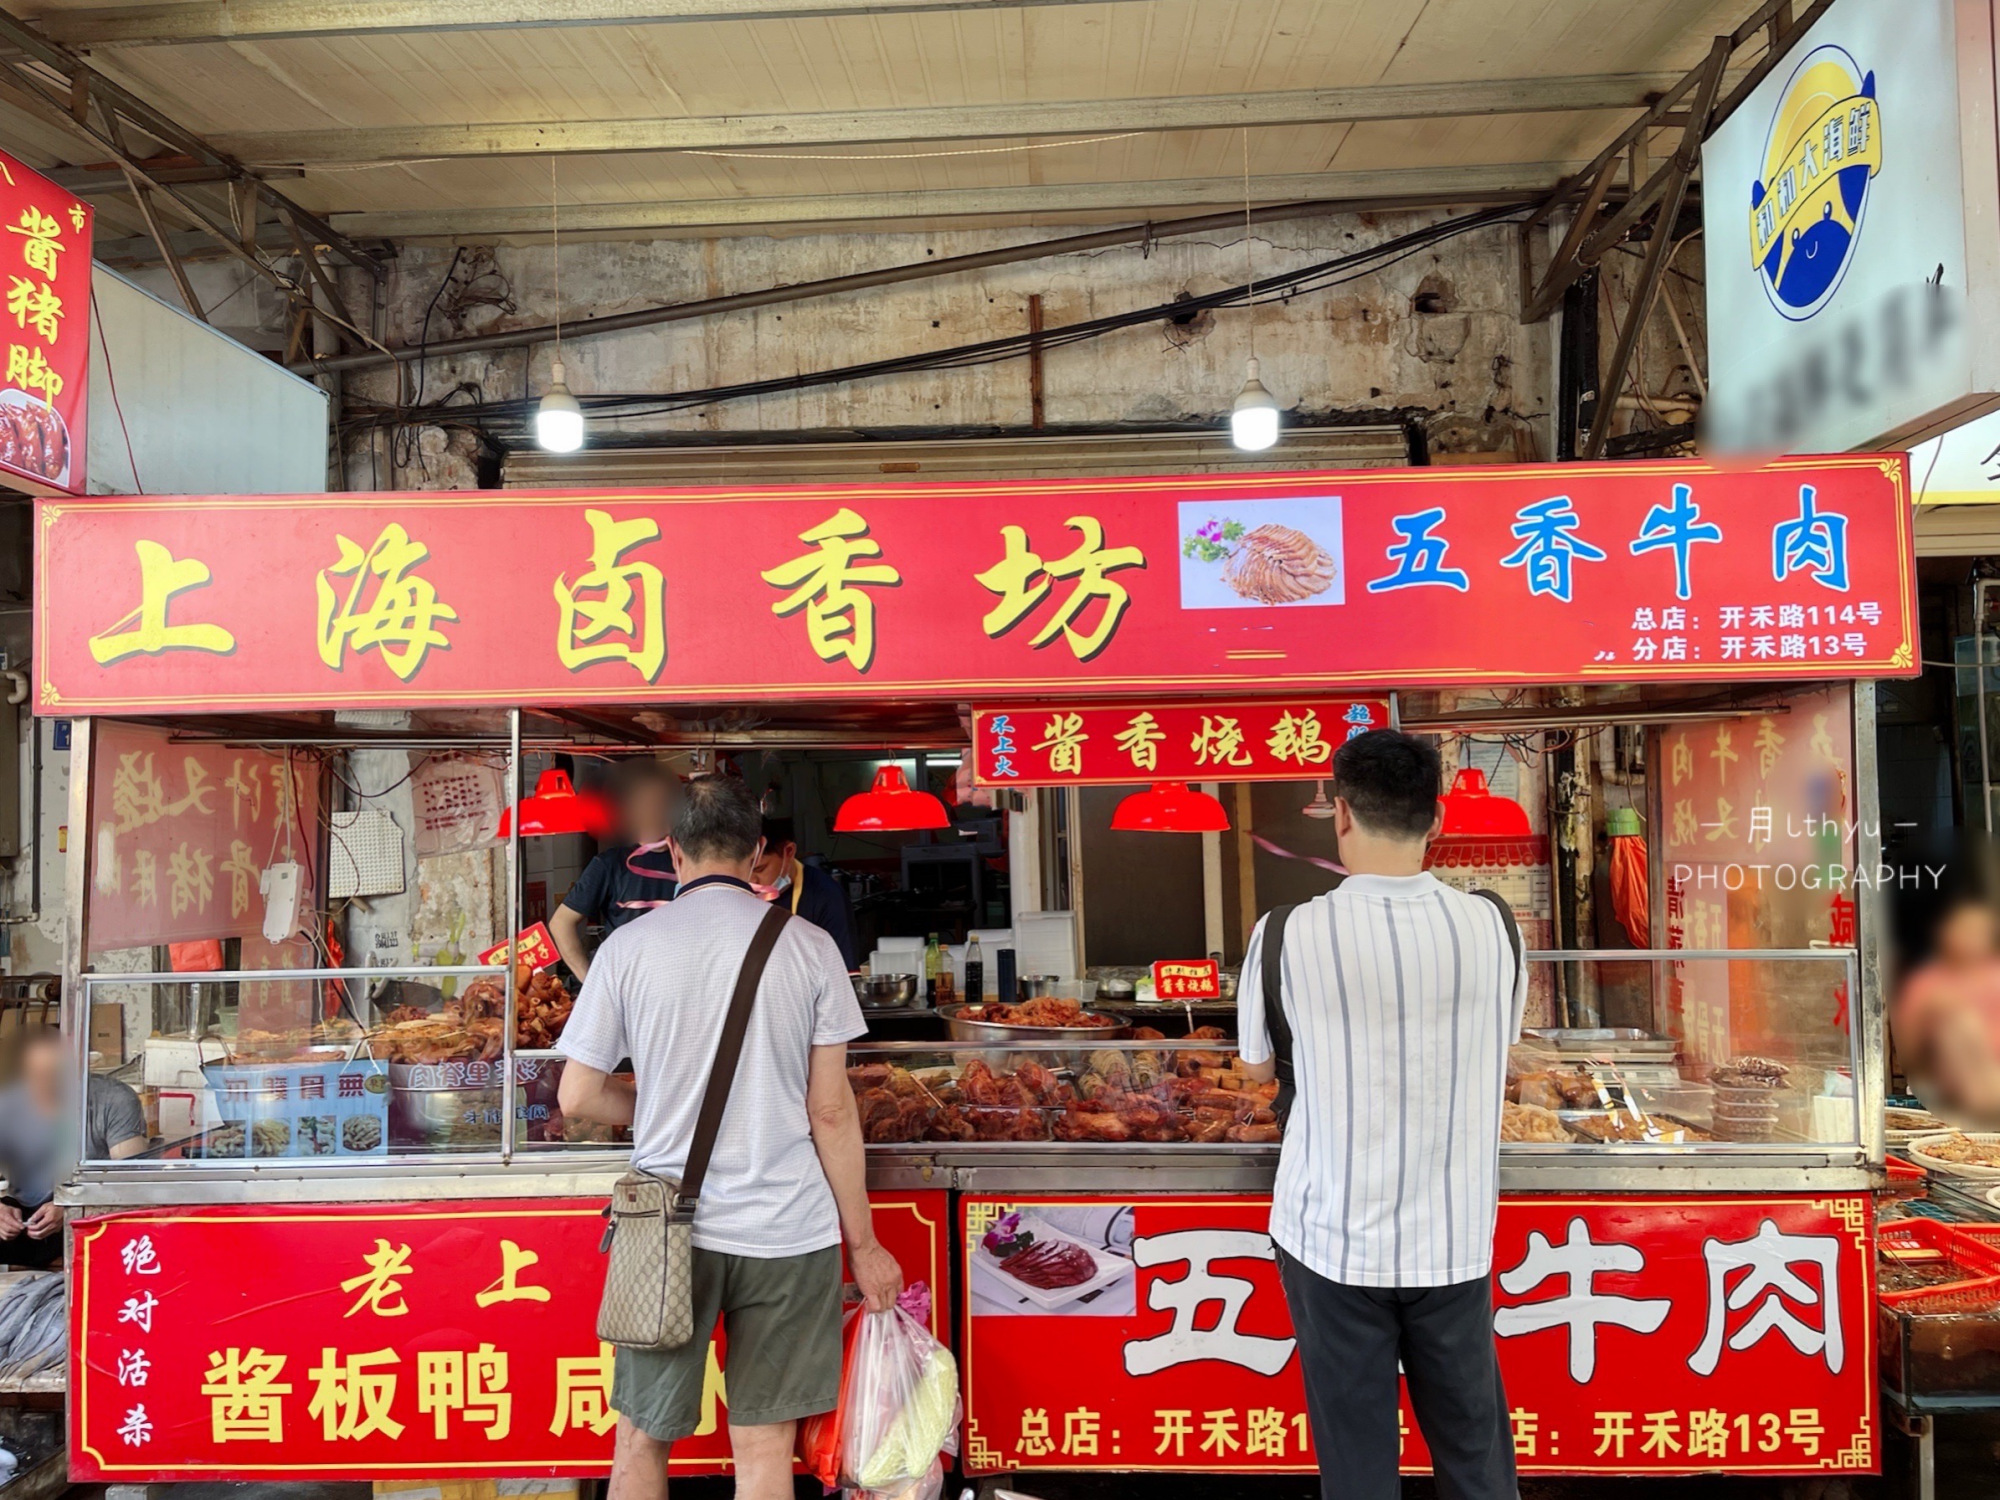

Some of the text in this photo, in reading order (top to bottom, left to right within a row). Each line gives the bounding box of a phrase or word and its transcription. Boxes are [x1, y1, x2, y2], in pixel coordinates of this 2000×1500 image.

[5, 204, 67, 414] 酱猪脚
[88, 508, 1147, 684] 上海卤香坊
[1366, 482, 1852, 602] 五香牛肉
[990, 714, 1019, 777] 不上火
[1031, 709, 1333, 776] 酱香烧鹅
[340, 1237, 552, 1318] 老上
[1122, 1216, 1844, 1386] 五牛肉
[117, 1235, 161, 1447] 绝对活杀
[200, 1342, 511, 1444] 酱板鸭
